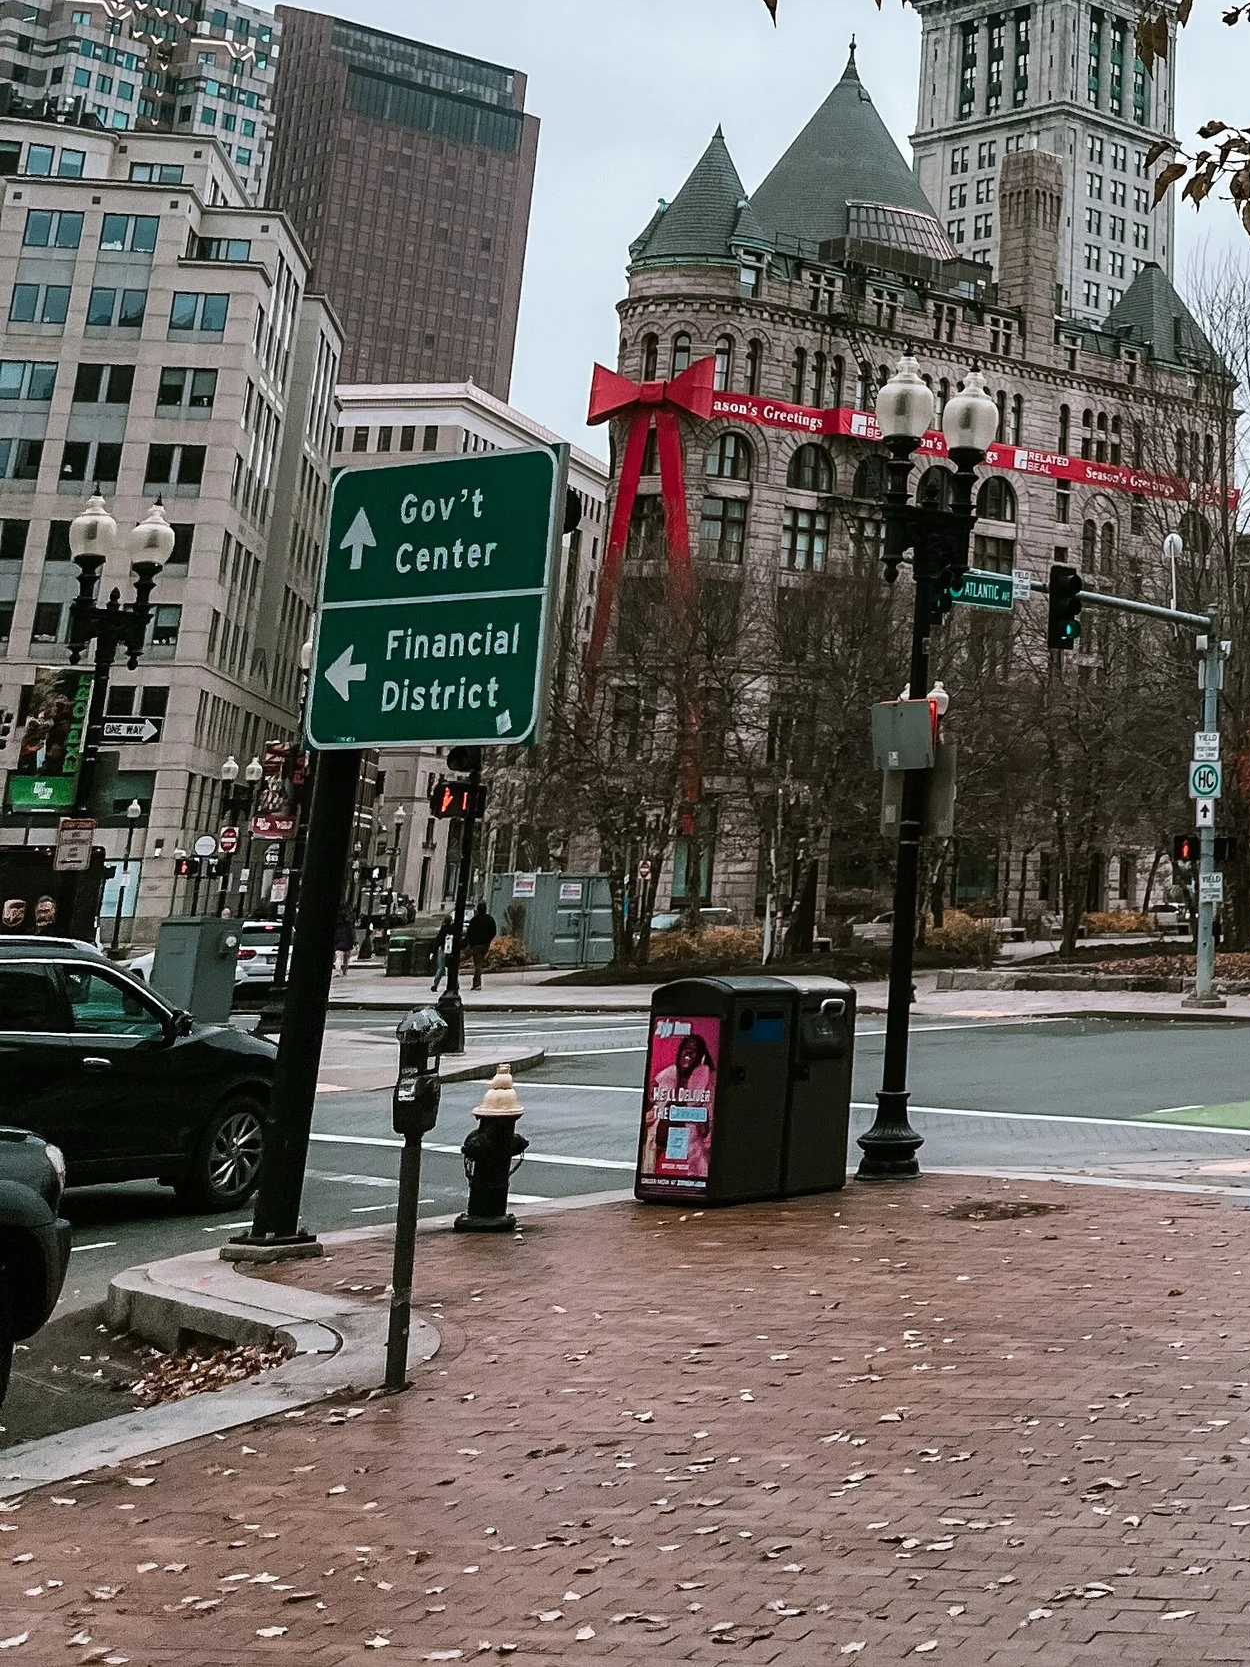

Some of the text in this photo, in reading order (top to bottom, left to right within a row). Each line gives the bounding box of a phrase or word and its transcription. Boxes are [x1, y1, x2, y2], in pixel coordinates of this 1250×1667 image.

[712, 399, 823, 432] ason's Greetings
[1027, 451, 1069, 467] RELATED
[1027, 461, 1052, 474] BEAL
[1085, 466, 1127, 485] Season's
[400, 487, 484, 524] Gov't
[395, 538, 499, 574] Center
[964, 581, 999, 601] ATLANTIC
[386, 622, 521, 661] Financial
[381, 676, 500, 712] District
[105, 724, 145, 735] ONE WAY
[1198, 734, 1218, 742] YIELD
[1198, 770, 1215, 788] HC
[1202, 875, 1222, 883] YIELD
